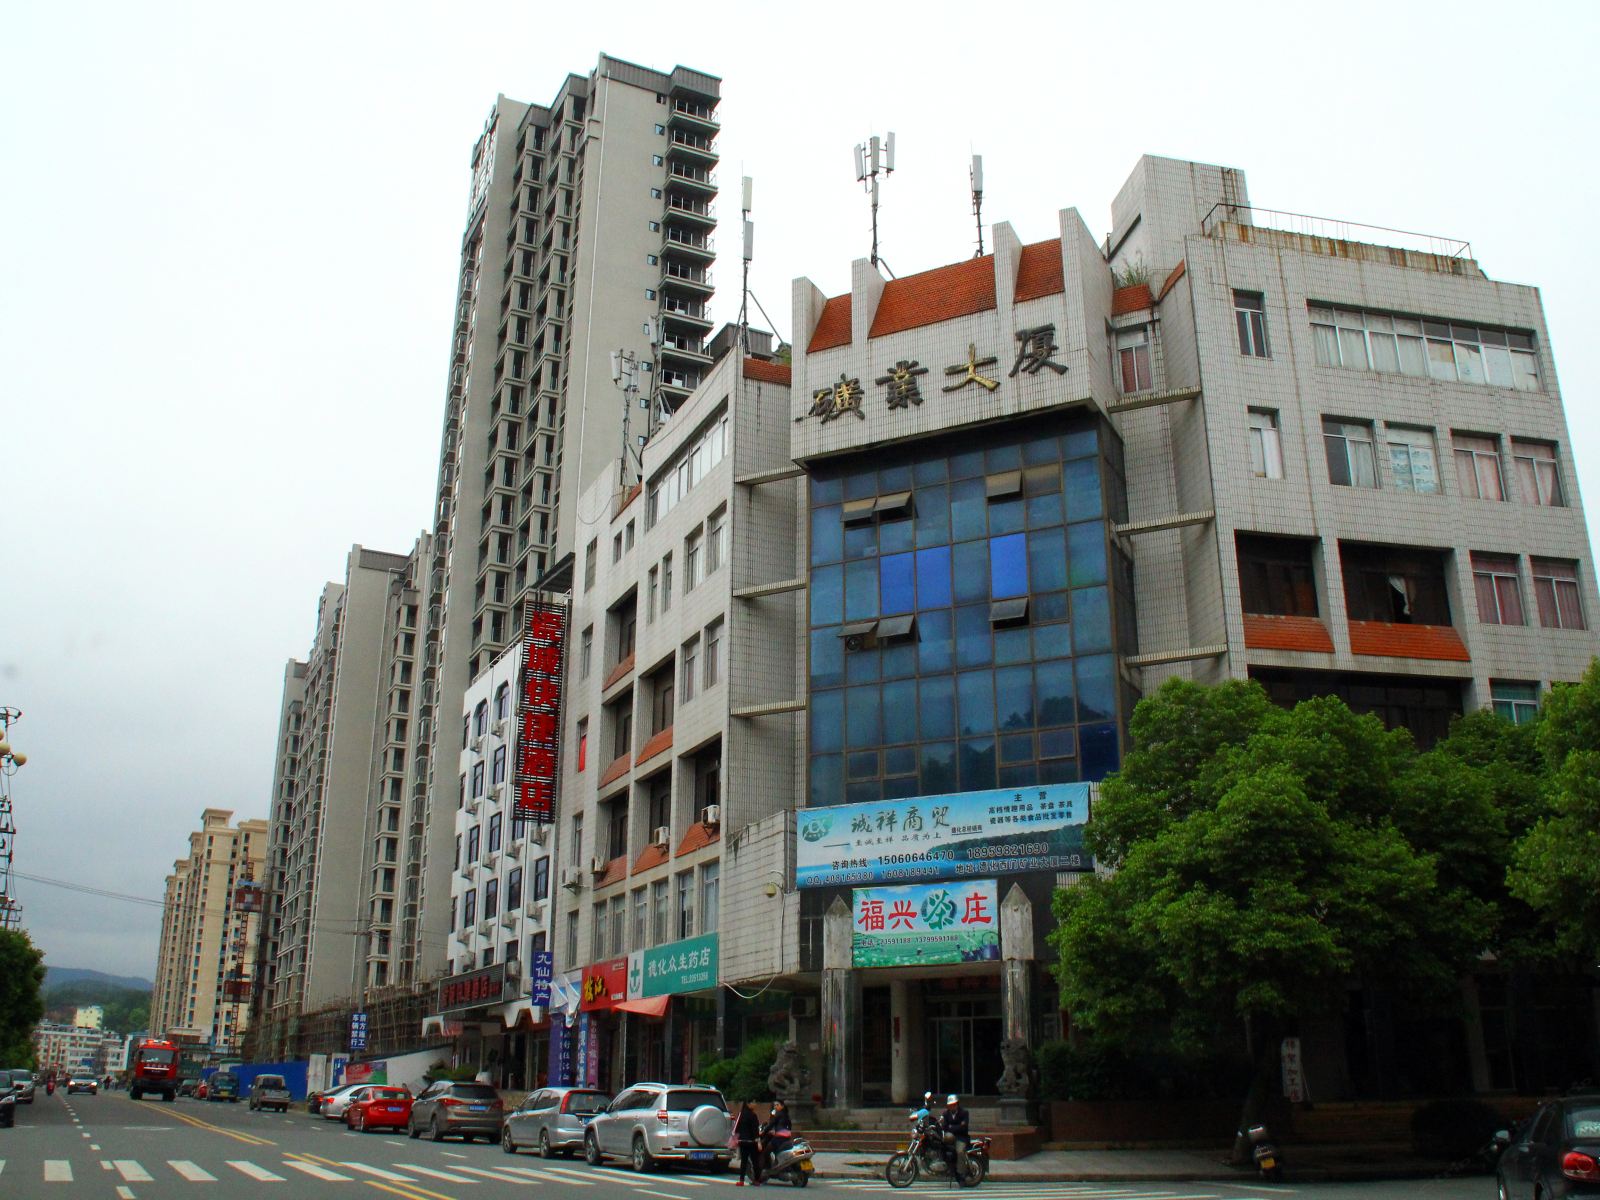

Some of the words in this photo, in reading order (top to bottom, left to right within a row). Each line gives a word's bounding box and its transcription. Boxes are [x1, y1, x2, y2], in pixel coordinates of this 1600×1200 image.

[851, 806, 949, 833] 诚祥商贸
[878, 850, 954, 865] 15060646470
[858, 889, 992, 931] 福兴茶庄
[648, 947, 711, 977] 德化众生药店
[534, 953, 552, 1003] 九仙特产
